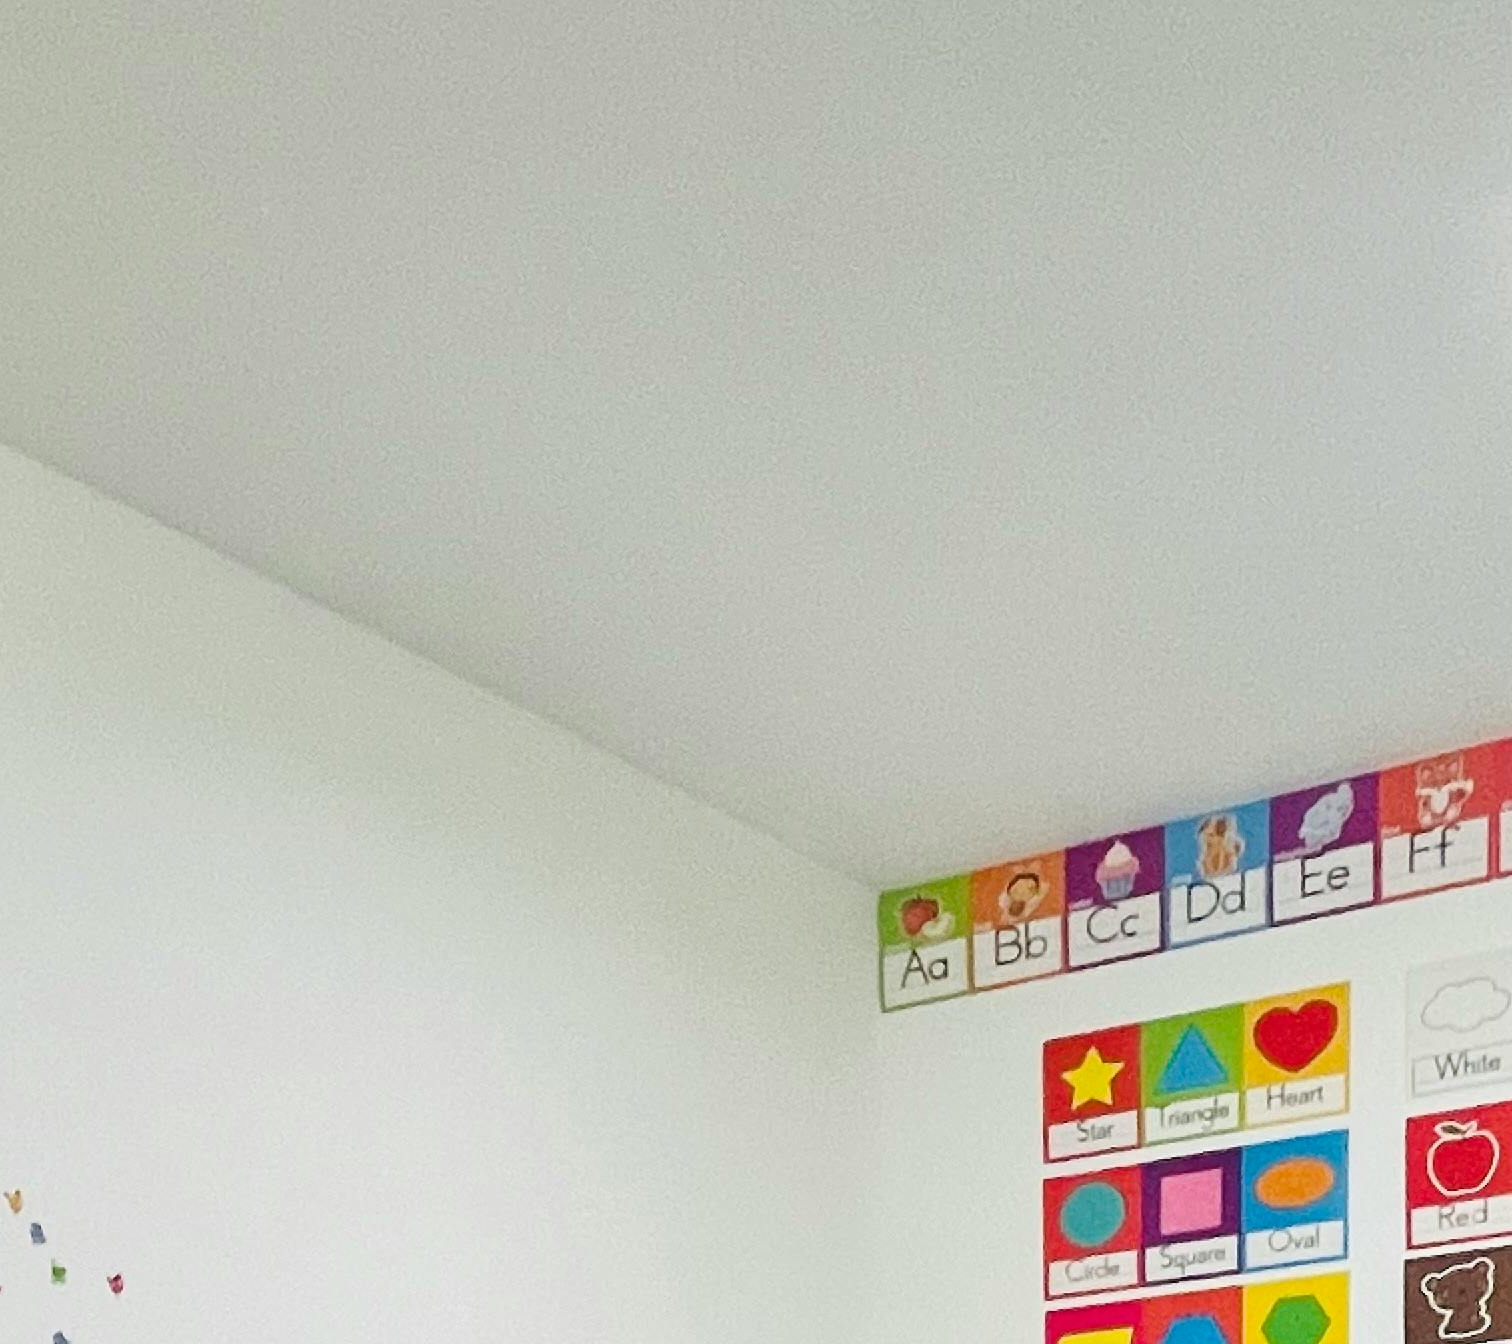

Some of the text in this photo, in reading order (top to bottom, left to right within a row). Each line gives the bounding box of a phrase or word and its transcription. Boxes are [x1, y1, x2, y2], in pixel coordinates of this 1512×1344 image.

[900, 825, 1461, 990] Aa Bb Cc Dd Ee Ff
[1434, 1053, 1502, 1081] White
[1266, 1083, 1325, 1111] Heart
[1076, 1118, 1115, 1142] Star
[1158, 1101, 1230, 1134] Triangle
[1437, 1206, 1489, 1229] Red
[1268, 1228, 1321, 1252] Oval
[1065, 1256, 1120, 1281] Circle
[1158, 1245, 1226, 1272] Square
